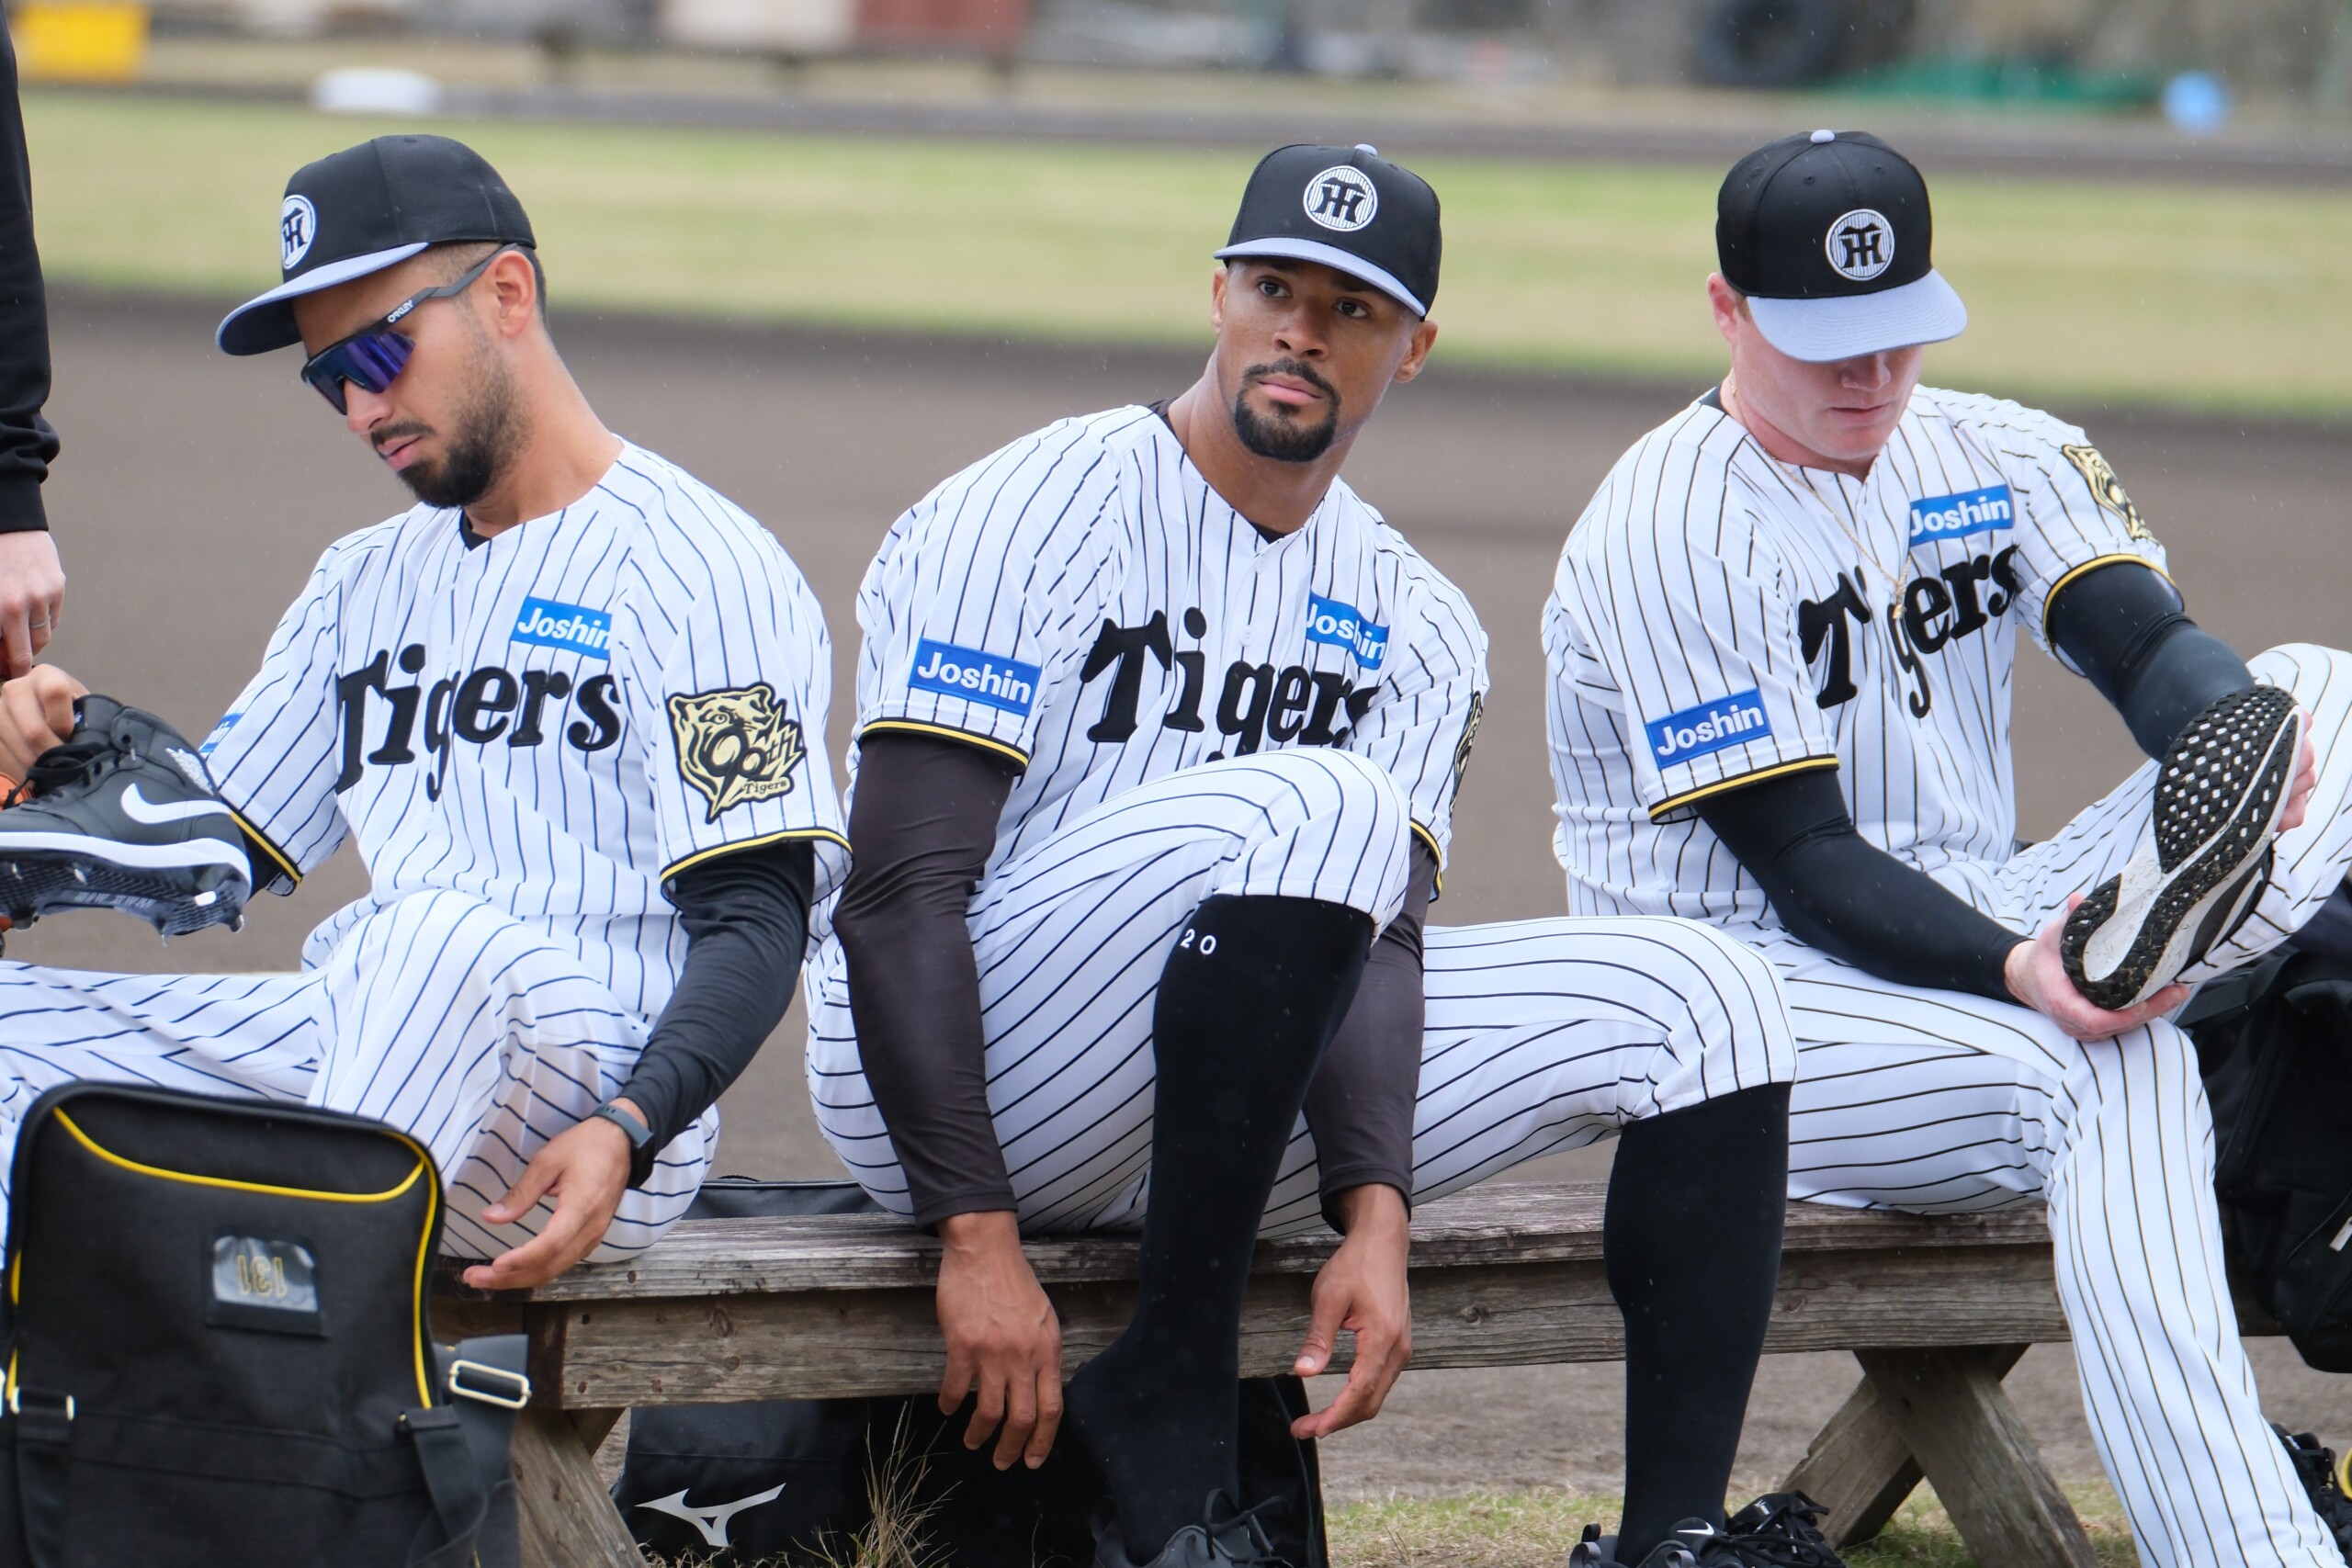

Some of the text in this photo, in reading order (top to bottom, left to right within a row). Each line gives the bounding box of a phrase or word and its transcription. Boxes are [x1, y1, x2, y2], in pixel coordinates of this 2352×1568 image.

[387, 299, 413, 323] OAKLEY
[1910, 495, 2011, 537] Joshin
[517, 607, 611, 650] Joshin
[1306, 603, 1386, 660] Joshin
[1798, 543, 2018, 719] Tgers
[917, 651, 1032, 705] Joshin
[1657, 704, 1765, 756] Joshin
[743, 780, 787, 795] Tigers
[236, 1254, 288, 1298] 131
